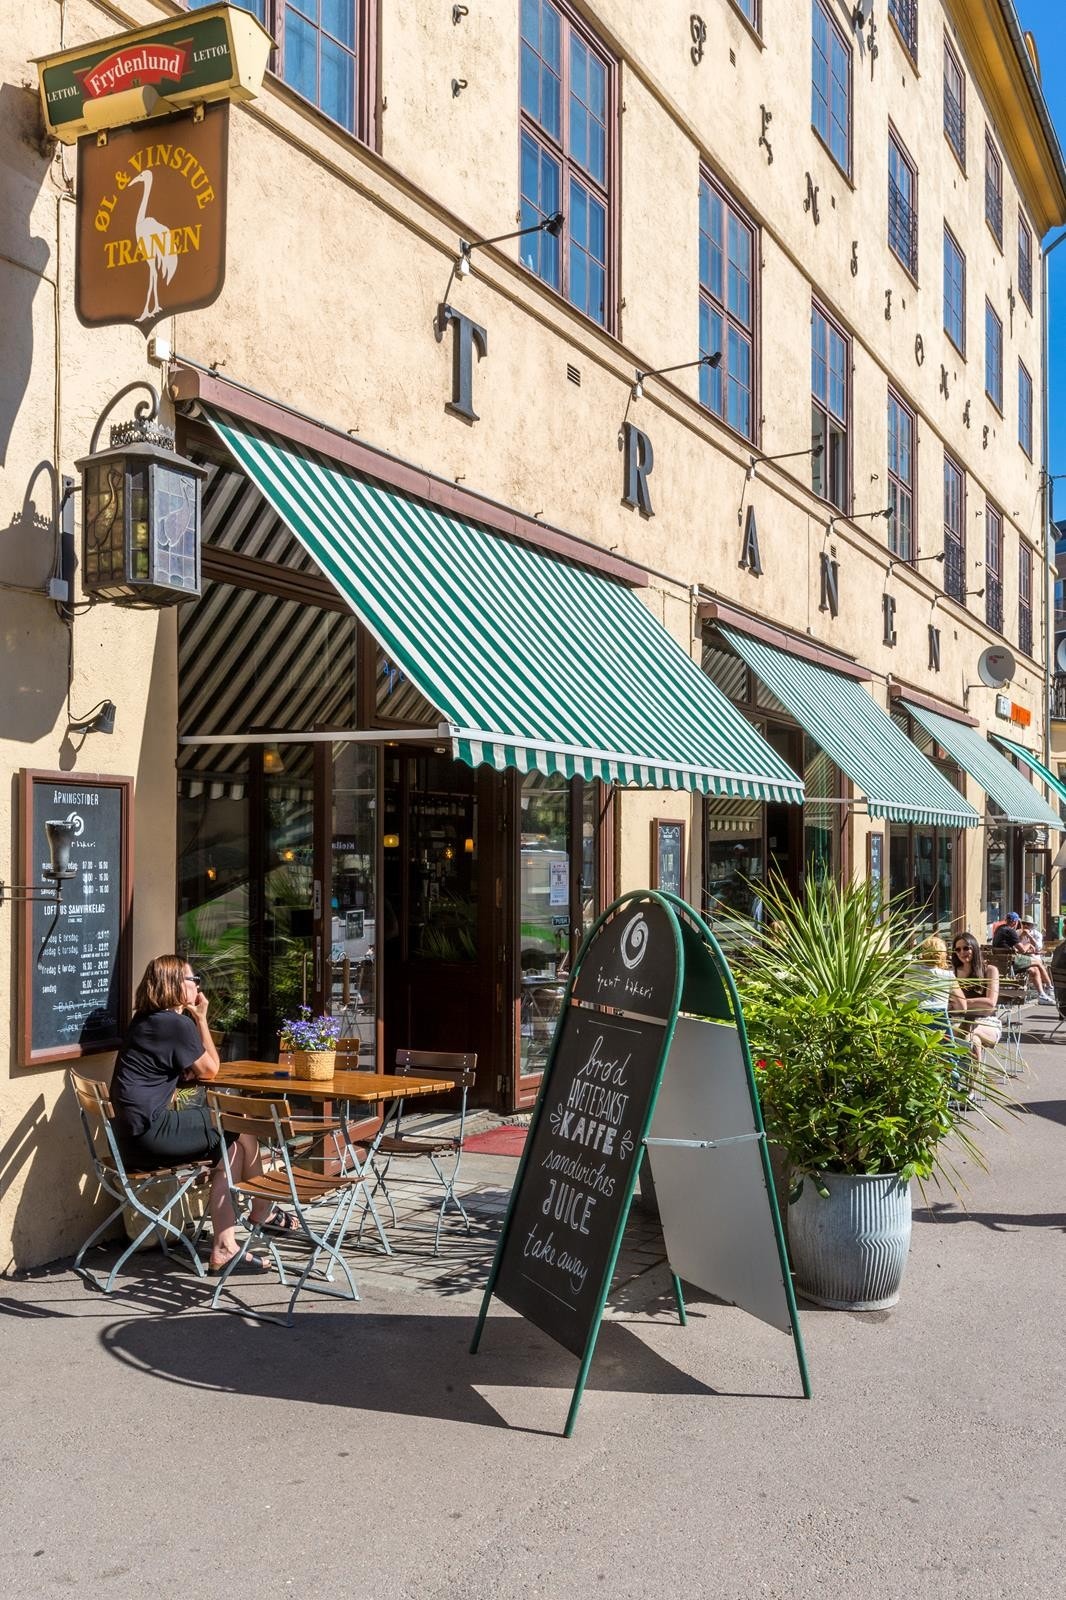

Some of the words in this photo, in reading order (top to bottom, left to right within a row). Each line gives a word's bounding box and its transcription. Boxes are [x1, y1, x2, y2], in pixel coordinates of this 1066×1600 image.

[90, 50, 181, 95] Frydenlund
[193, 44, 230, 64] LETTØL
[95, 194, 118, 233] ØL
[115, 170, 132, 191] &
[128, 143, 216, 210] VINSTUE
[104, 224, 203, 269] TRANEN
[443, 303, 941, 673] TRANEN
[43, 905, 67, 916] LOFTUS
[68, 904, 106, 915] SAMVIRKELAG
[625, 977, 653, 999] bakeri
[577, 1036, 632, 1087] brød
[567, 1078, 630, 1126] HVETEBAKST
[559, 1111, 618, 1156] KAFFE
[542, 1150, 616, 1197] sandwiches
[542, 1178, 597, 1235] JUICE
[524, 1223, 556, 1264] take
[557, 1250, 589, 1294] away
